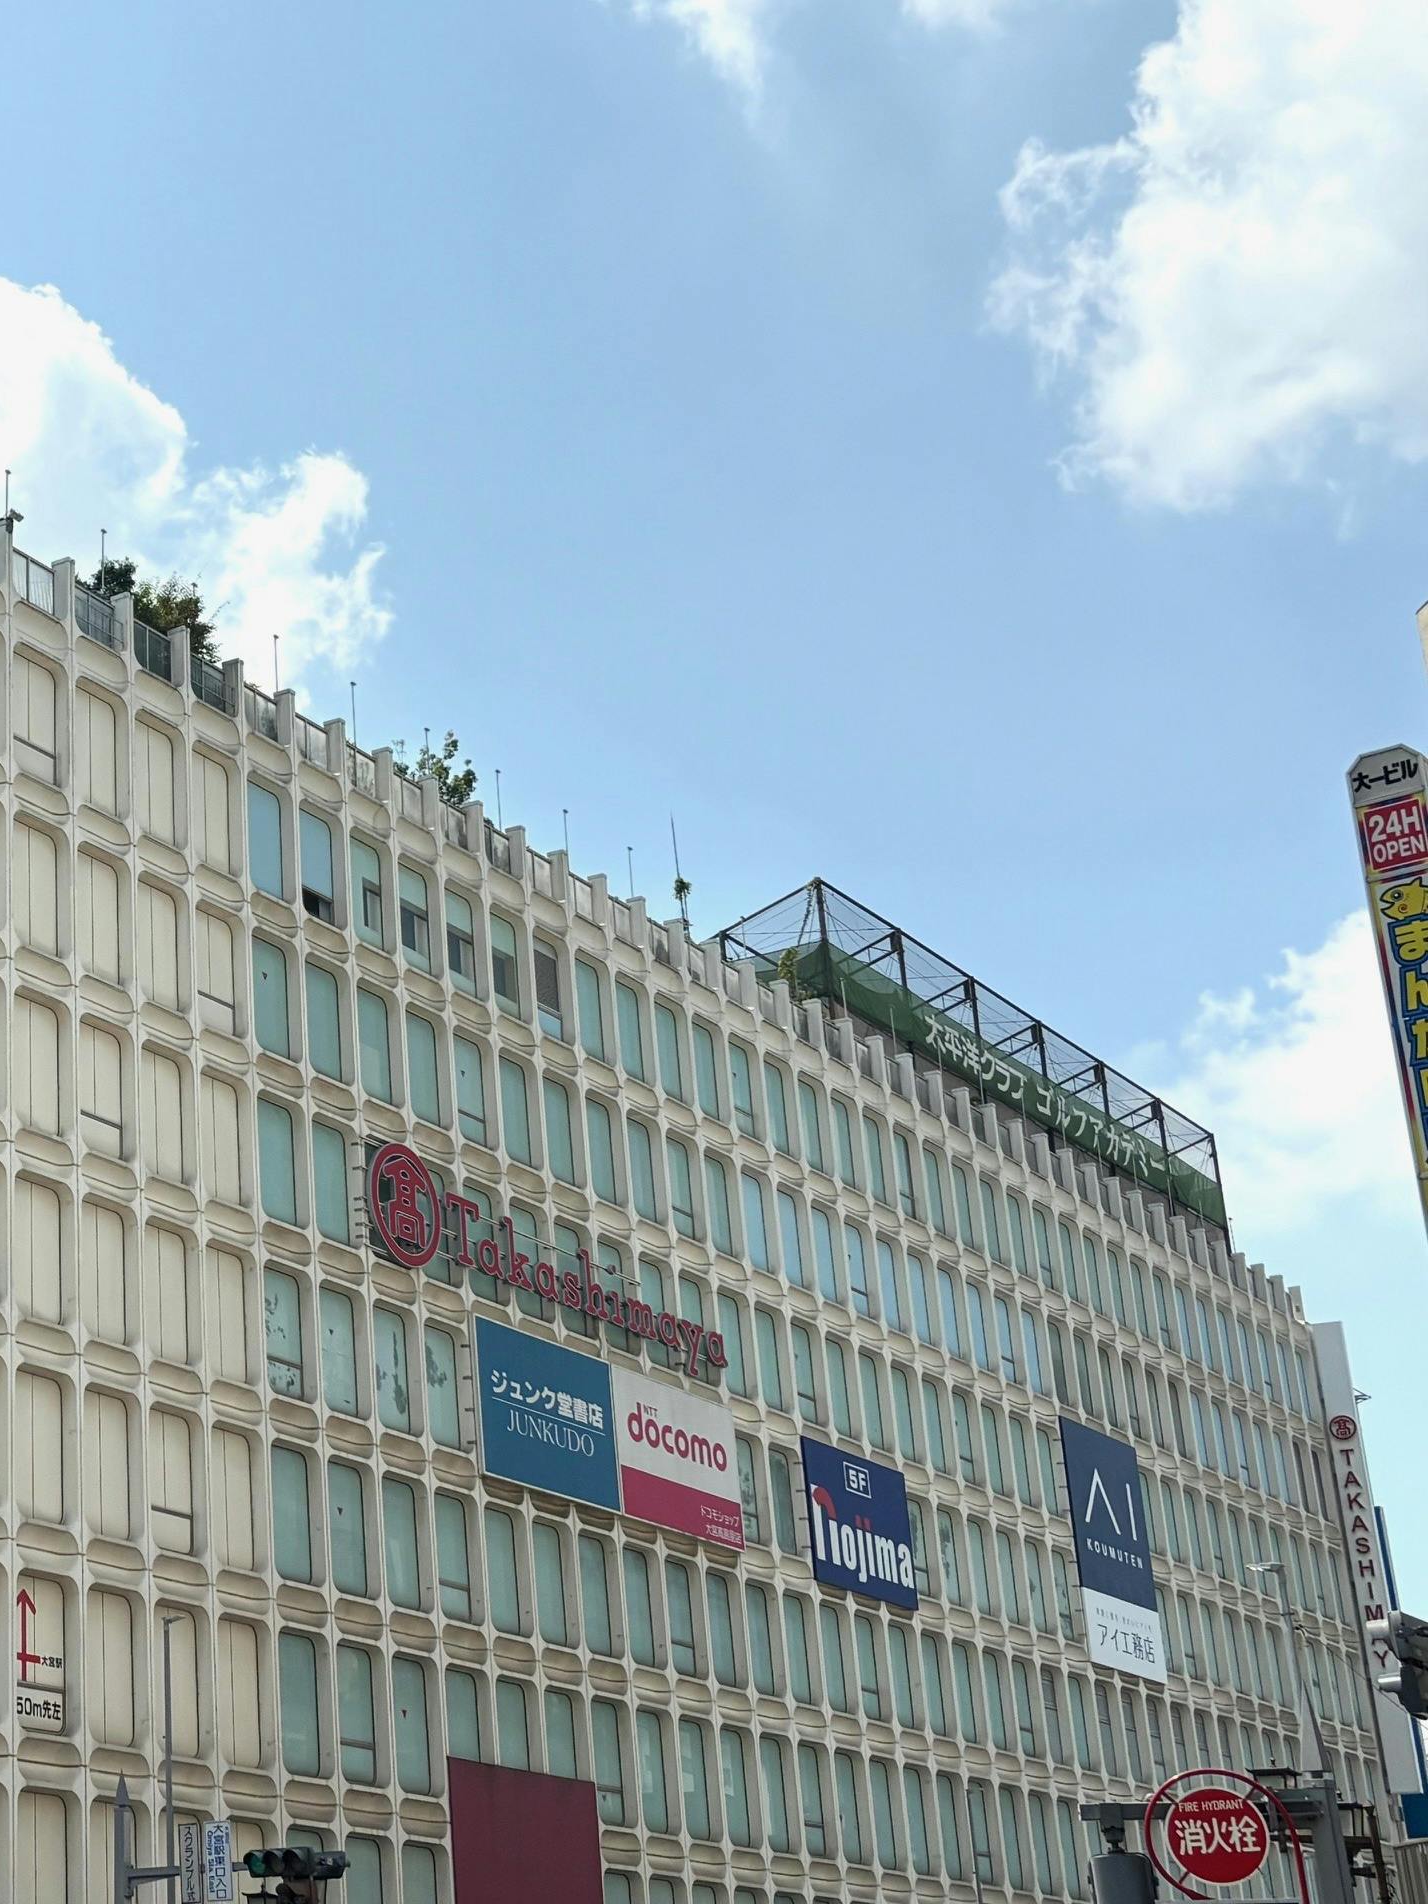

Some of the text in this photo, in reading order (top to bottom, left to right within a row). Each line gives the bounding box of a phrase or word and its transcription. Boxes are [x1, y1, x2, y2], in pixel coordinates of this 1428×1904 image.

[1368, 806, 1422, 843] 24H
[1373, 834, 1426, 863] OPEN
[924, 1015, 1166, 1178] 太平洋クラブ ゴルフアカデミー
[444, 1191, 729, 1376] Takashimaya
[491, 1369, 604, 1430] ジュンク堂書店
[643, 1404, 658, 1418] NTT
[507, 1409, 595, 1457] JUNKUDO
[627, 1401, 727, 1472] docomo
[848, 1469, 868, 1491] 5F
[1086, 1537, 1144, 1570] KOUMUTEN
[41, 1656, 62, 1669] 大宮駅
[1097, 1624, 1156, 1664] アイ工務店
[1178, 1799, 1245, 1813] FIRE HYDRANT
[1174, 1815, 1261, 1856] 消火栓
[213, 1824, 227, 1899] 大宮駅東口入口
